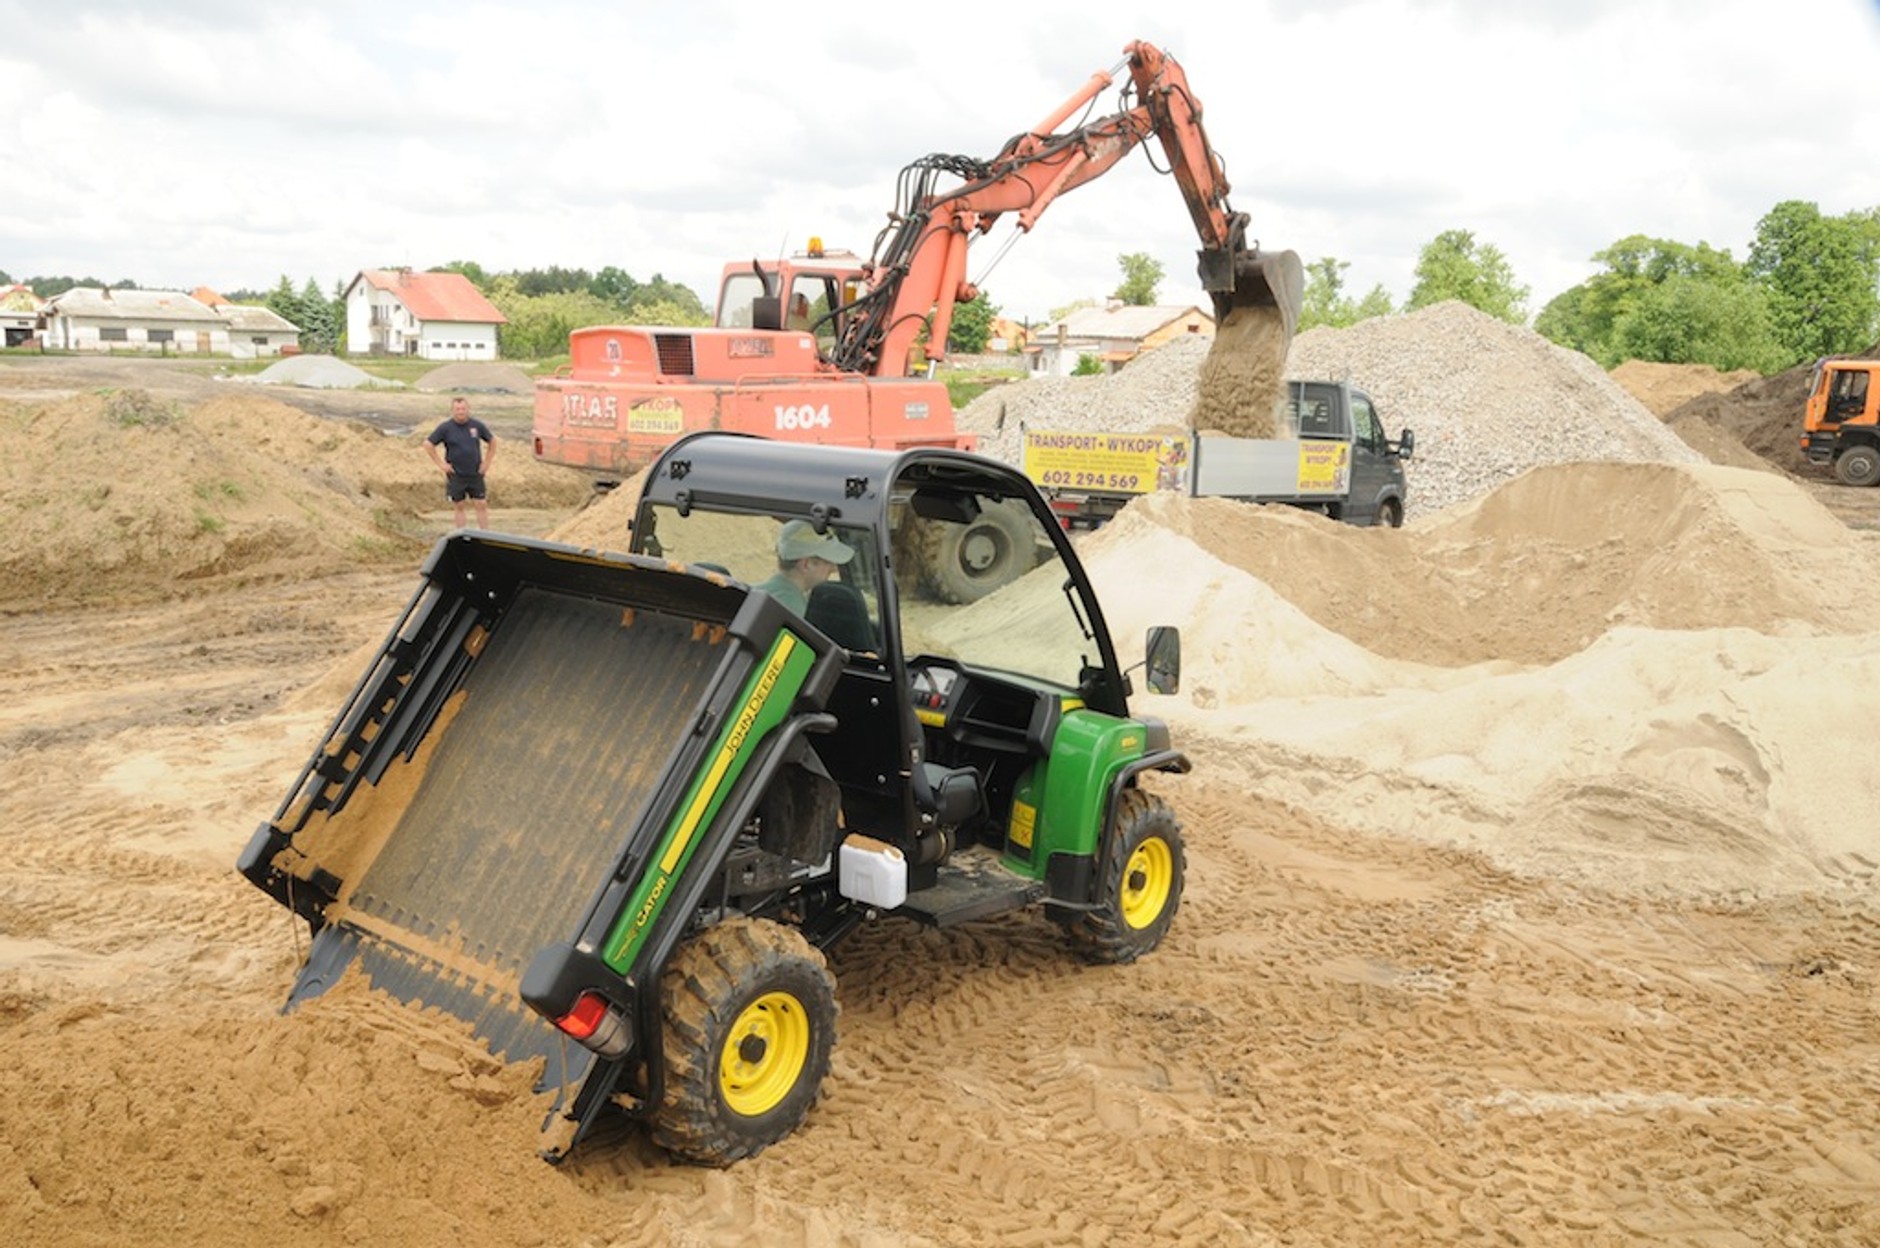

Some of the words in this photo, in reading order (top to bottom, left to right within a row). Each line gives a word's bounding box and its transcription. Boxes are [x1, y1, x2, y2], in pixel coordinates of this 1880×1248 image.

[774, 404, 832, 430] 1604
[1028, 433, 1098, 450] TRANSPORT
[1107, 437, 1162, 453] WYKOPY
[1042, 470, 1072, 485] 602
[1076, 471, 1106, 487] 294
[1109, 474, 1139, 489] 569
[726, 712, 757, 758] JOHN
[748, 658, 784, 713] DEERE
[636, 876, 666, 927] GATOR
